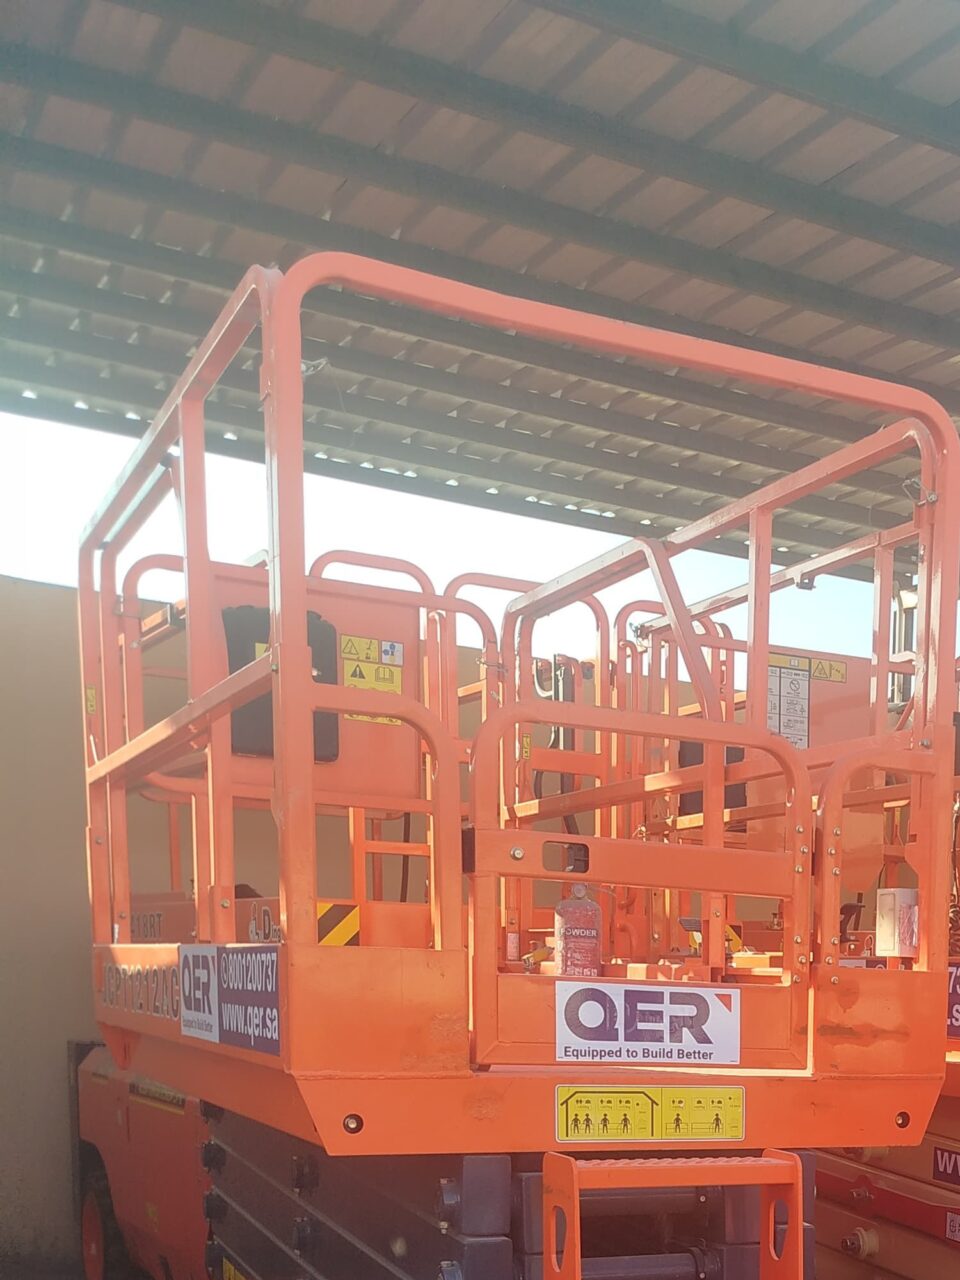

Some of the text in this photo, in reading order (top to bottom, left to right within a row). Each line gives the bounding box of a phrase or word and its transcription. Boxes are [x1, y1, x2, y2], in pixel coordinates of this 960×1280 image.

[560, 928, 597, 938] POWDER
[181, 954, 212, 1015] QER
[228, 952, 277, 992] 8001200737
[222, 1003, 279, 1046] www.qer.sa
[564, 987, 714, 1045] QER
[563, 1046, 713, 1060] Equipped to Build Better
